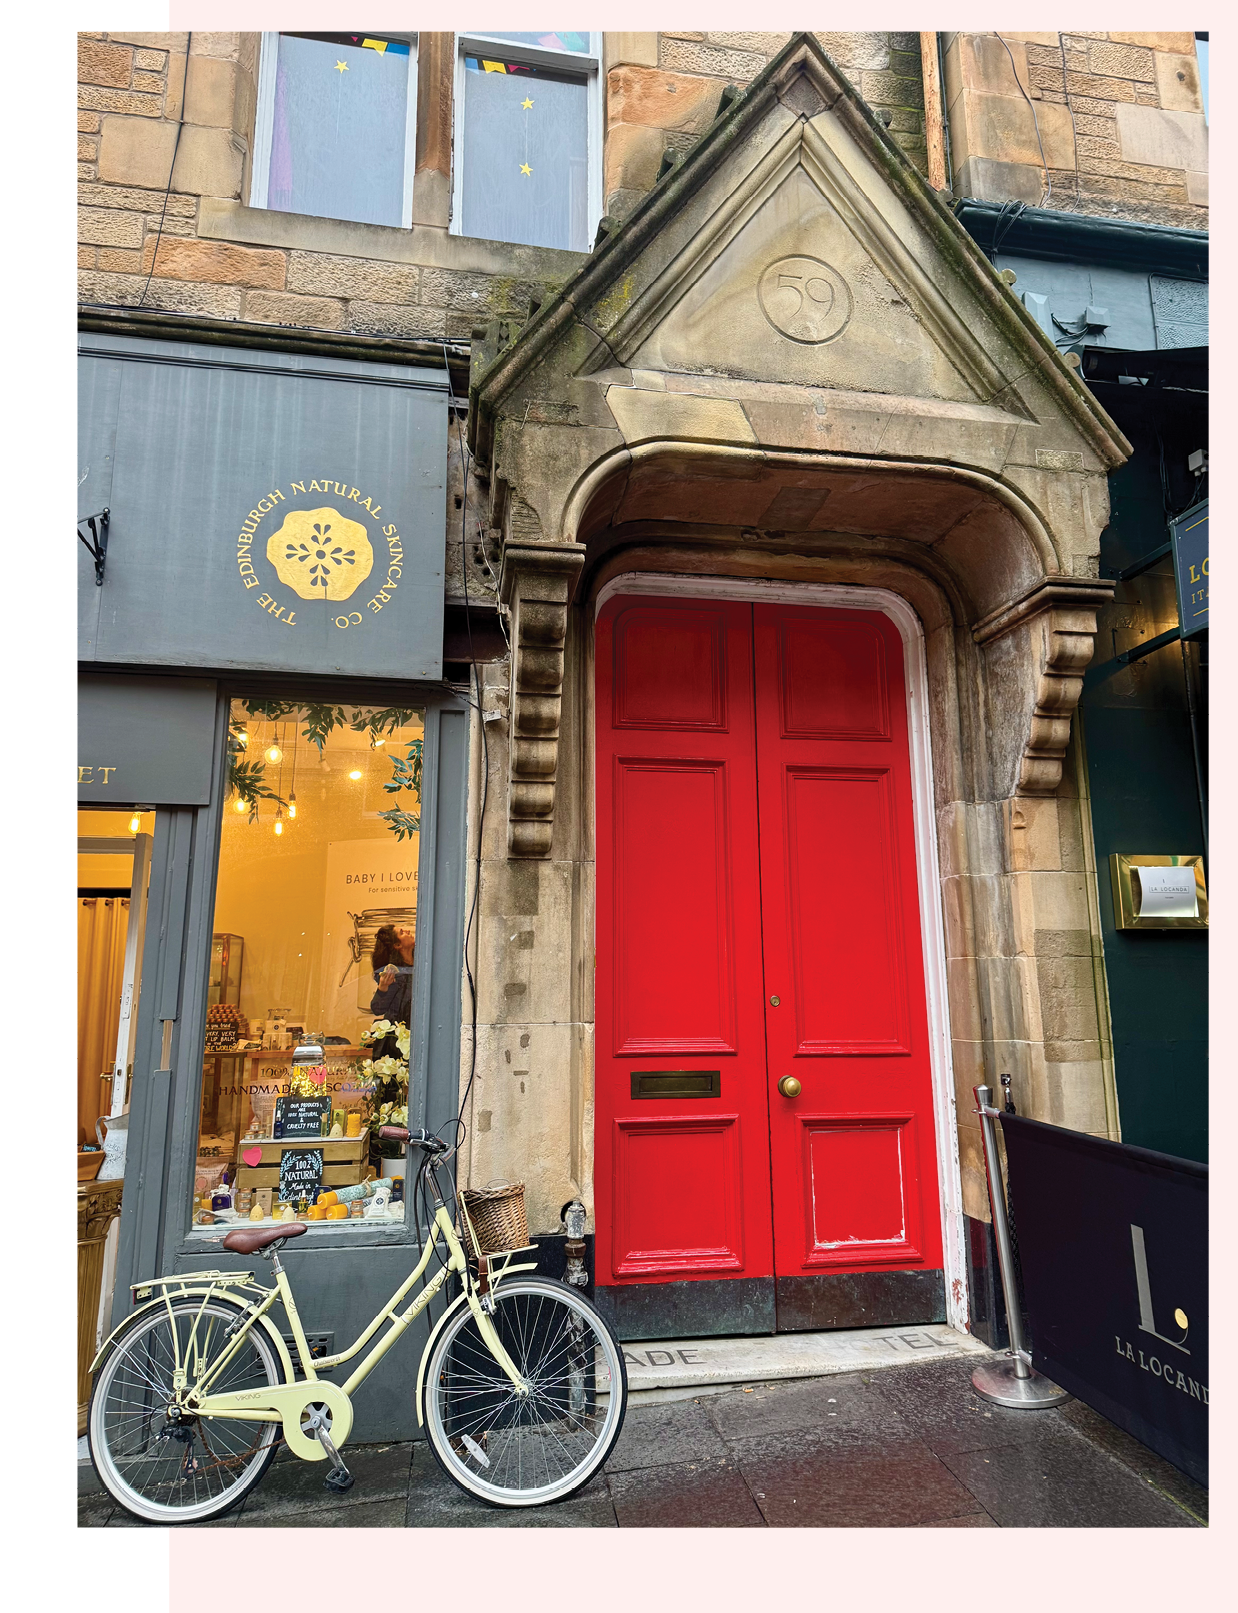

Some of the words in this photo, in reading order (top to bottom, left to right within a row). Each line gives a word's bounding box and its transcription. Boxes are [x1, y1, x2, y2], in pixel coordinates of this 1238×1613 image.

[776, 274, 837, 322] 59
[290, 479, 383, 520] NATURAL
[236, 489, 286, 590] EDINBURGH
[366, 523, 404, 614] SKINCARE
[256, 592, 297, 626] THE
[77, 766, 117, 785] ET
[345, 873, 376, 885] BABY
[381, 873, 384, 882] I
[389, 871, 418, 882] LOVE
[284, 1169, 319, 1182] NATURAL
[288, 1182, 305, 1191] Made
[304, 1181, 311, 1189] in
[404, 1275, 443, 1317] VIKING
[1114, 1335, 1136, 1363] LA
[234, 1392, 262, 1402] VIKING
